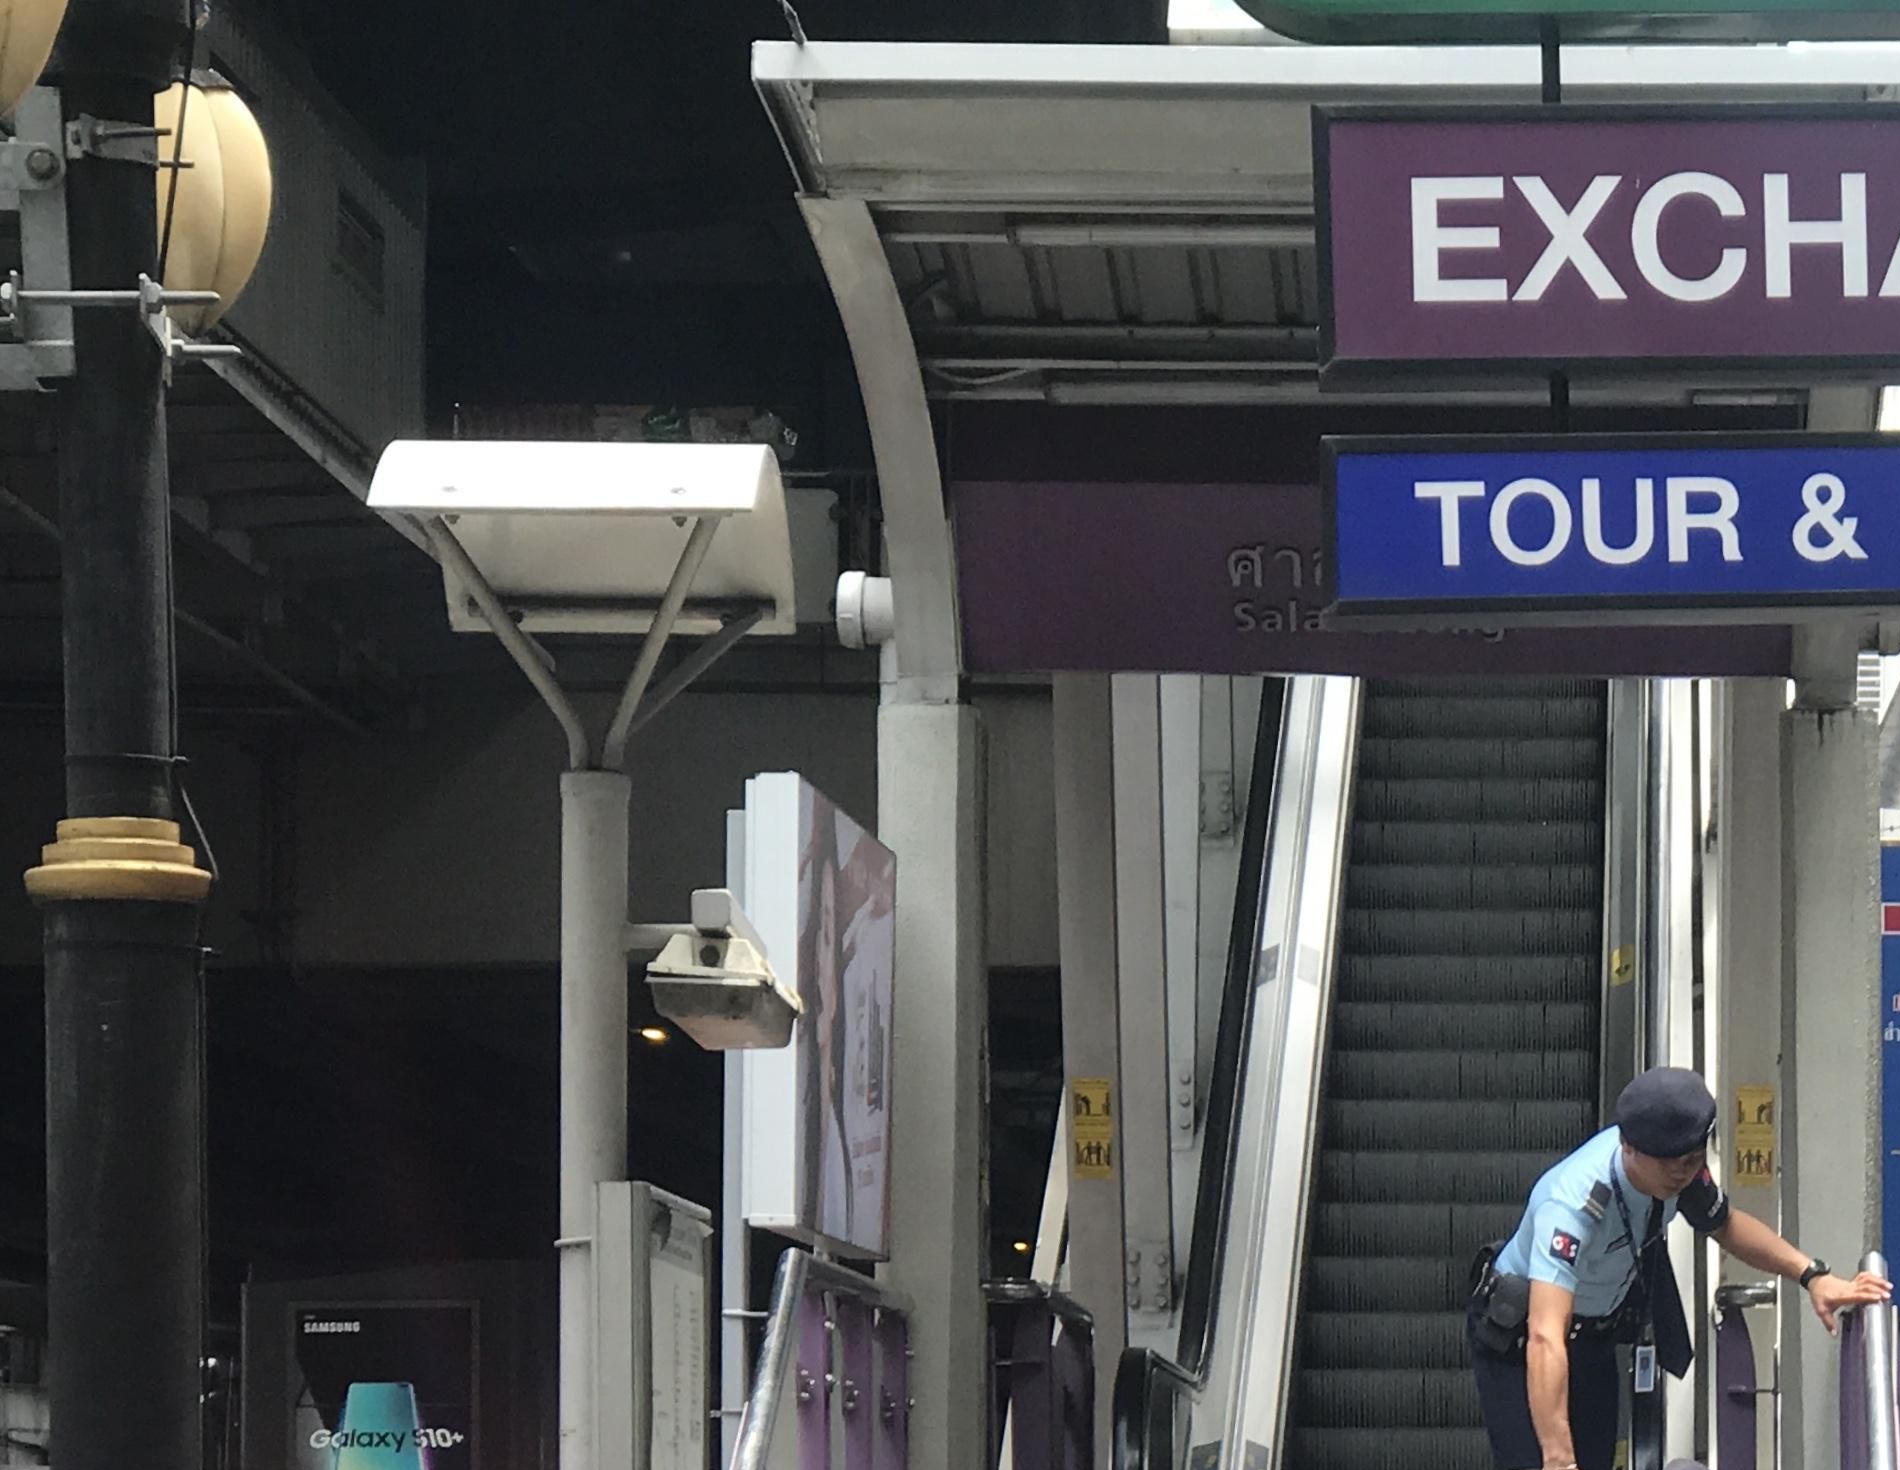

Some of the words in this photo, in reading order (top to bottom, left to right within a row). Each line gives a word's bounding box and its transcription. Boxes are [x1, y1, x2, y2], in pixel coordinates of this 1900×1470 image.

[1414, 477, 1741, 568] TOUR
[1792, 472, 1869, 561] &
[304, 1321, 361, 1333] SAMSUNG
[309, 1429, 405, 1453] Galaxy
[412, 1428, 464, 1449] S10+
